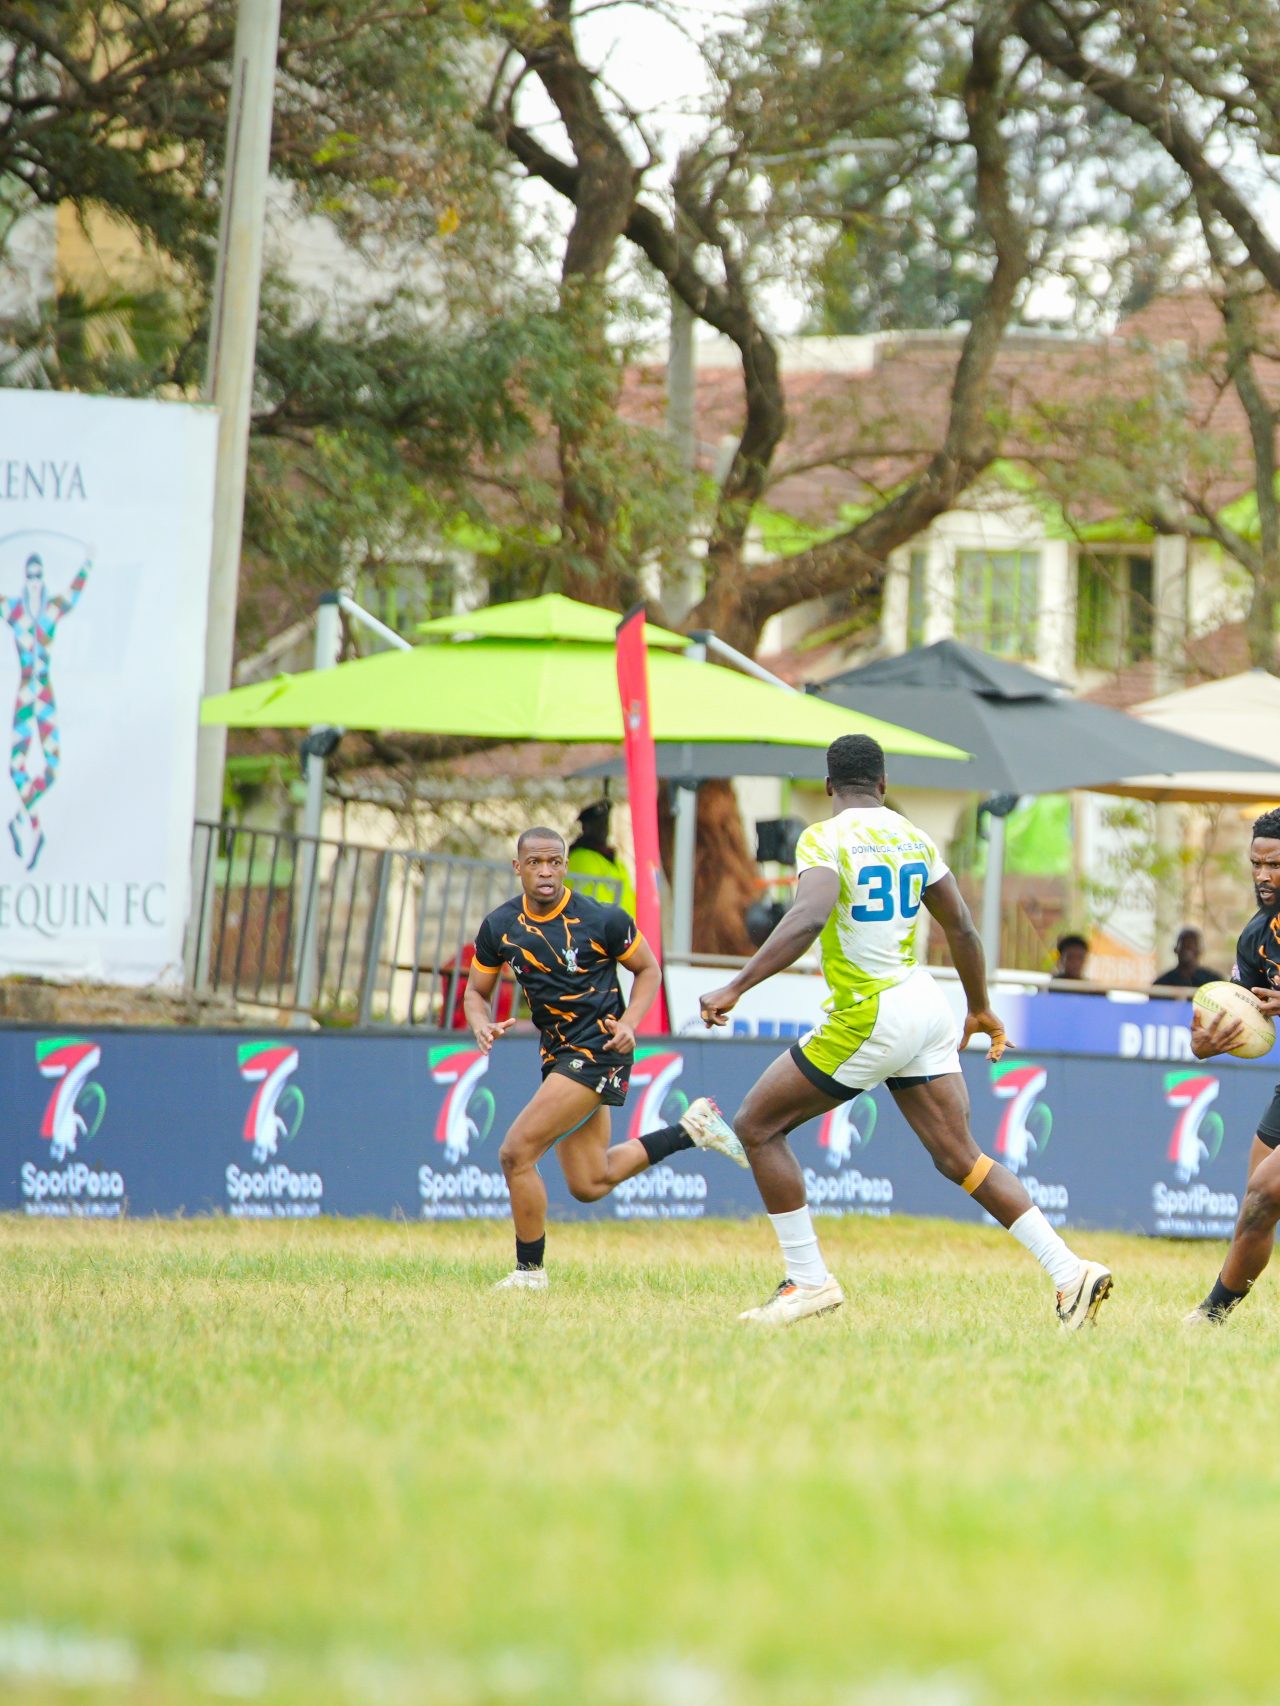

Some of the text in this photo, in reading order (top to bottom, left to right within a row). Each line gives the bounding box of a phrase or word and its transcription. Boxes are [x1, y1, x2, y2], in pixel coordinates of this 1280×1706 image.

[0, 460, 88, 500] ENYA
[125, 881, 167, 927] FC
[851, 862, 929, 923] 30
[21, 1161, 124, 1201] SportPesa
[225, 1163, 323, 1202] SportPesa
